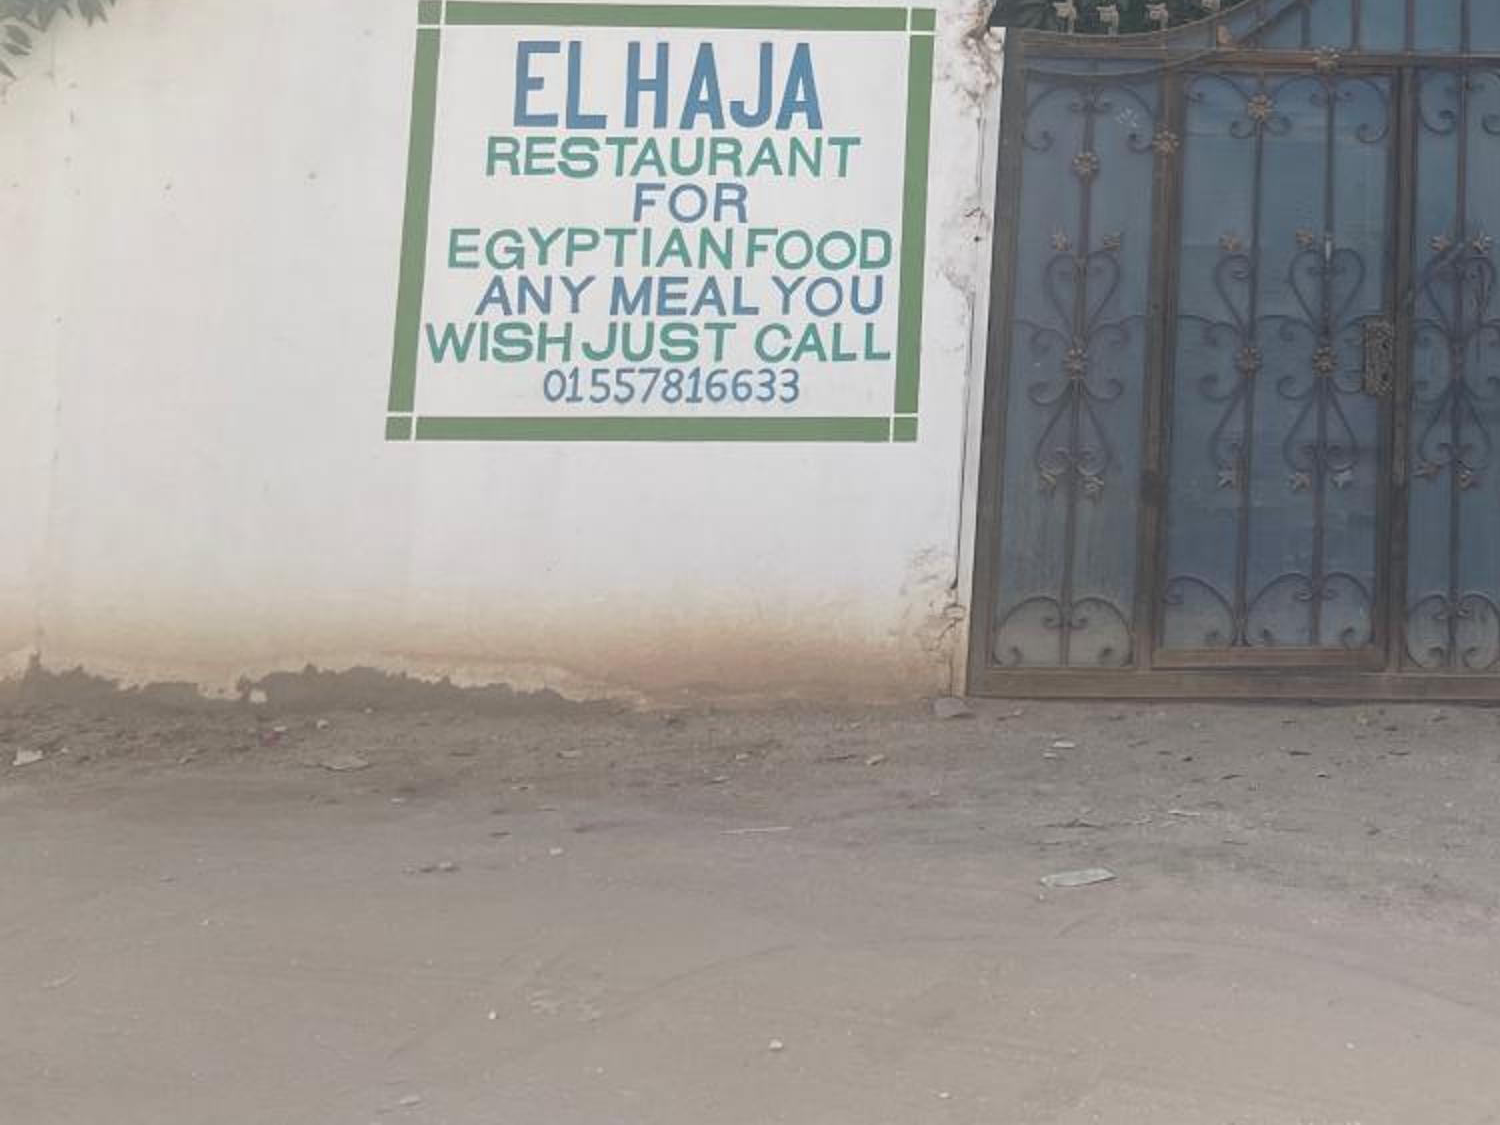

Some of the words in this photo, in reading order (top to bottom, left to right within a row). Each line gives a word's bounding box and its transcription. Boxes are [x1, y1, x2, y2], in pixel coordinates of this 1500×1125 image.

[513, 40, 607, 129] EL
[624, 41, 823, 130] HAJA
[486, 136, 861, 178] RESTAURANT
[633, 183, 748, 223] FOR
[448, 228, 734, 269] EGYPTIAN
[745, 228, 893, 271] FOOD
[475, 276, 595, 316] ANY
[609, 276, 759, 316] MEAL
[772, 276, 884, 316] YOU
[426, 323, 573, 364] WISH
[581, 322, 736, 363] JUST
[754, 323, 891, 363] CALL
[542, 368, 800, 404] 01557816633
